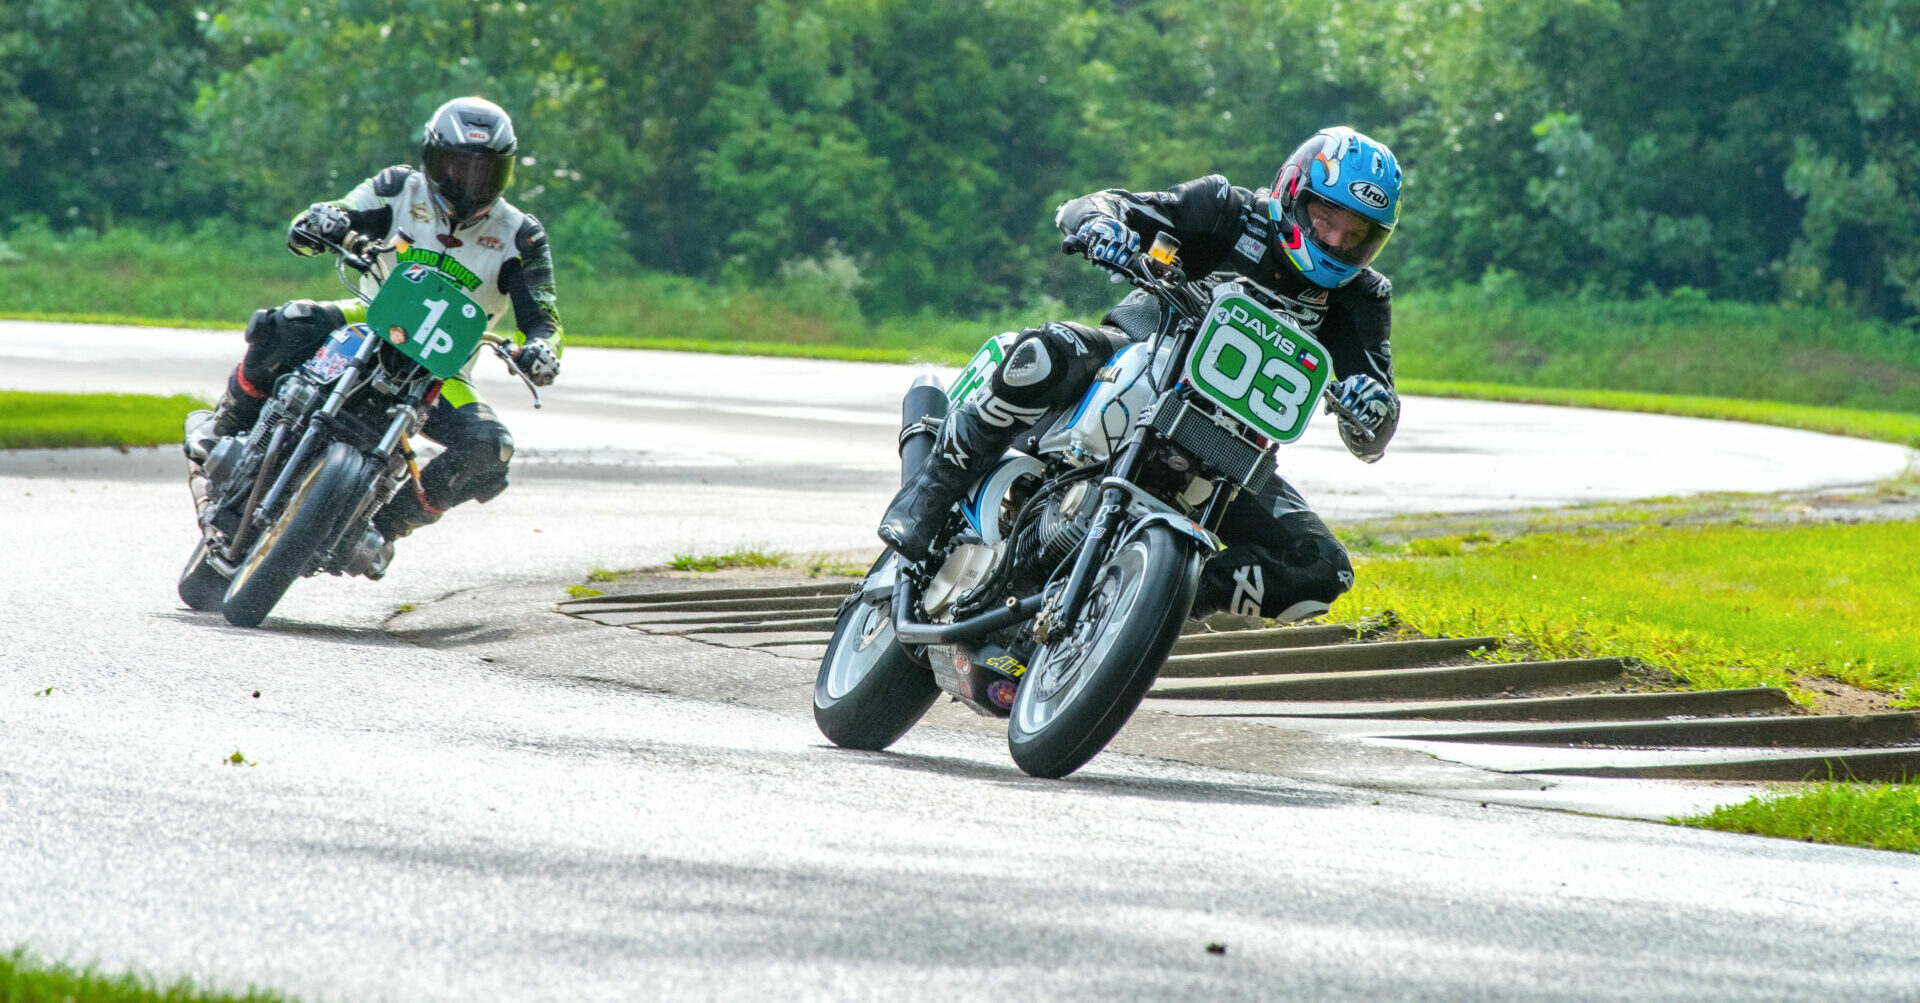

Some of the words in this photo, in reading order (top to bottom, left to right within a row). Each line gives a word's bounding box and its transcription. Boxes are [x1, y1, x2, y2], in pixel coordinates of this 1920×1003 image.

[1352, 183, 1387, 206] Arai
[440, 254, 483, 292] HOUSE
[1230, 304, 1297, 357] DAVIS
[1198, 324, 1312, 433] 03
